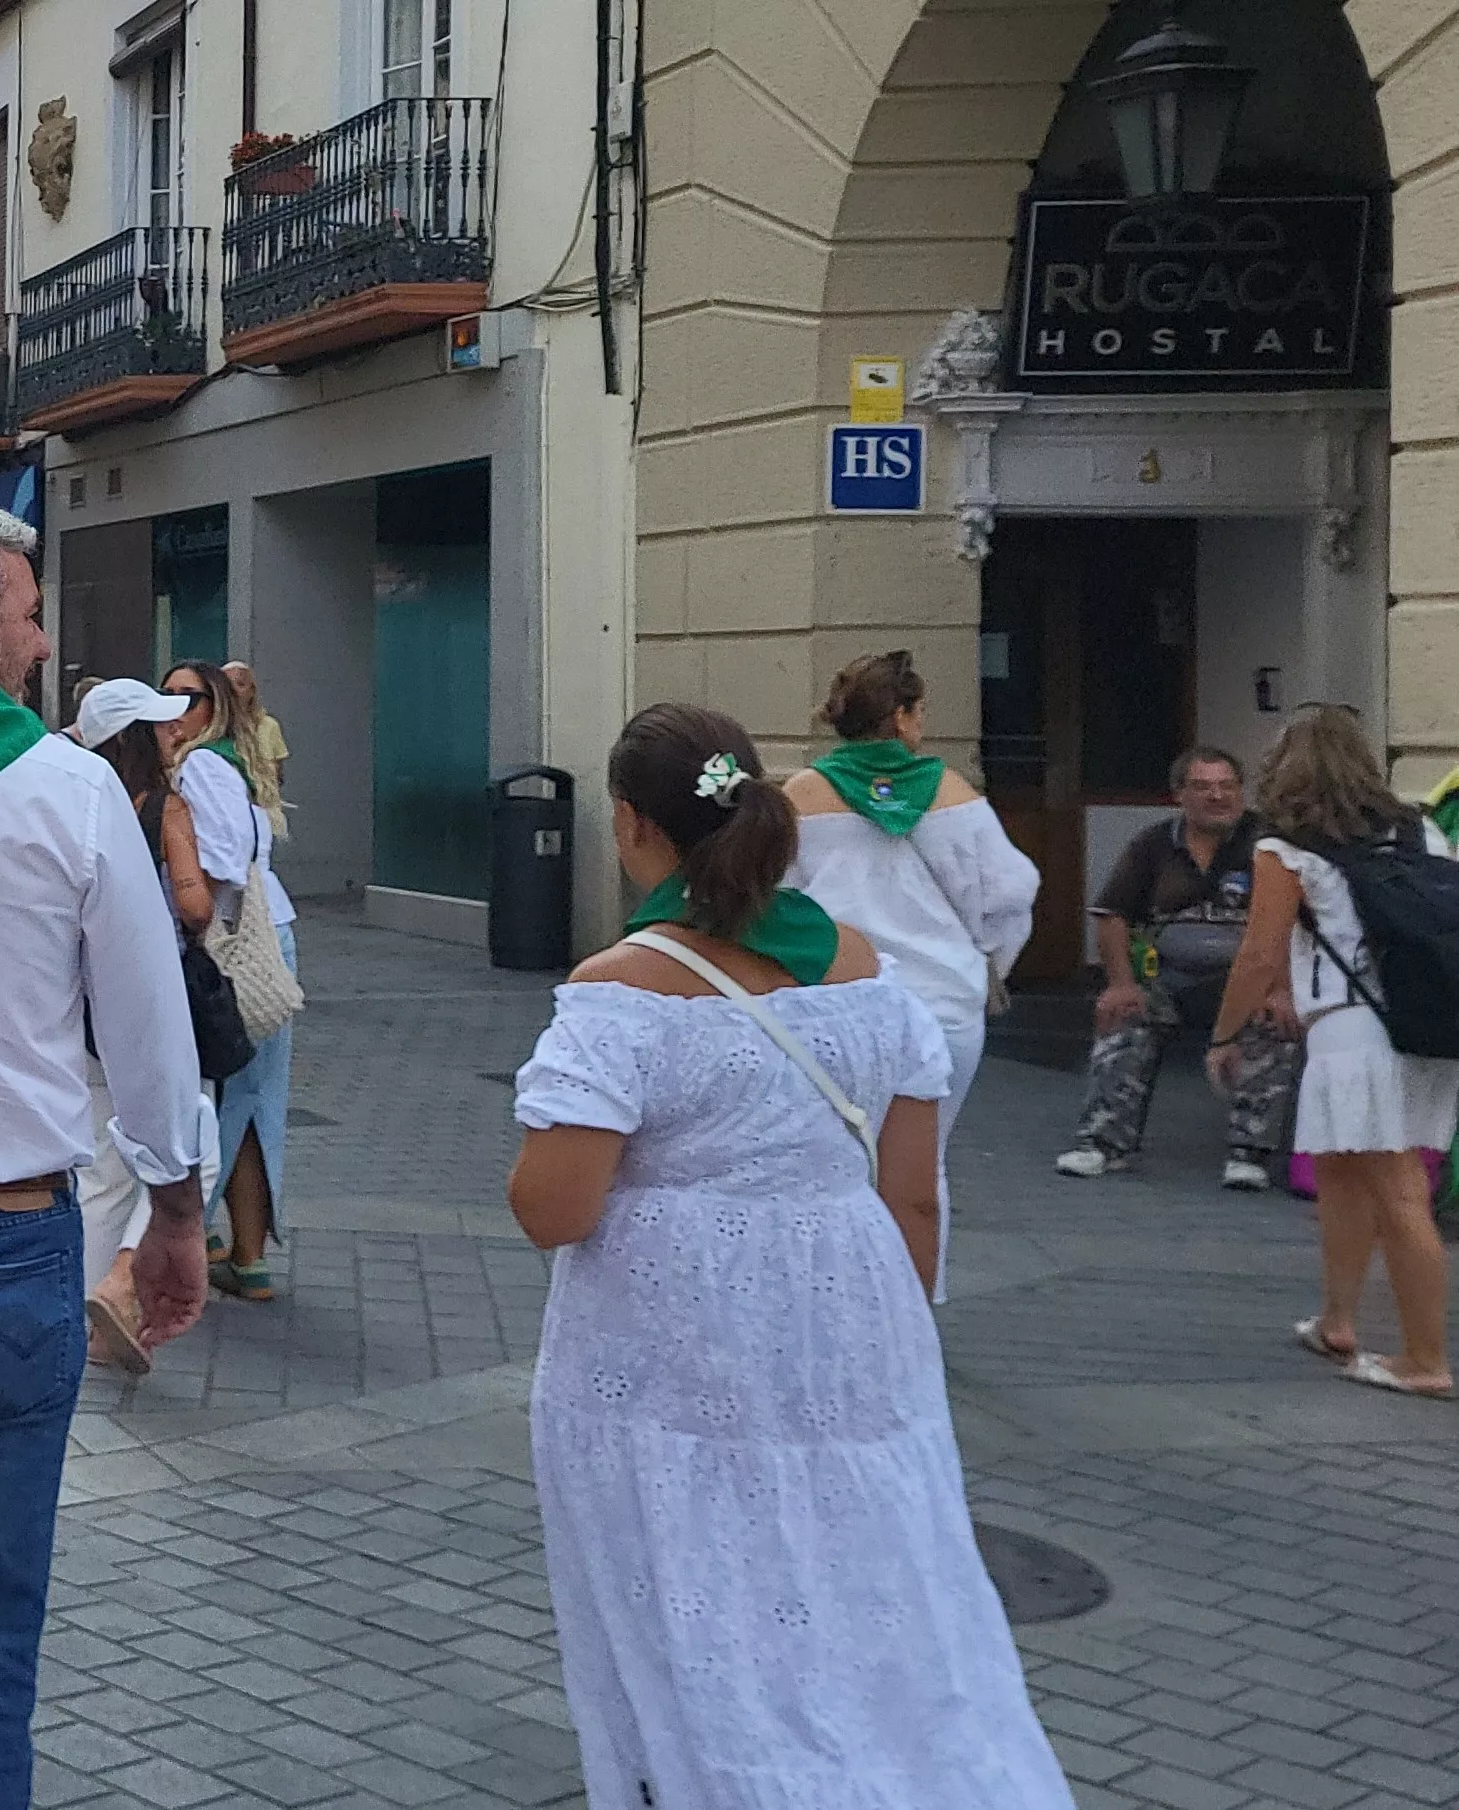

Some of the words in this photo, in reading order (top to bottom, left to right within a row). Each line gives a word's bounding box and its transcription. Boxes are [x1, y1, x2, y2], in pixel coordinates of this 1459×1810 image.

[1041, 261, 1339, 314] RUGACA
[1037, 328, 1335, 355] HOSTAL
[840, 436, 912, 479] HS
